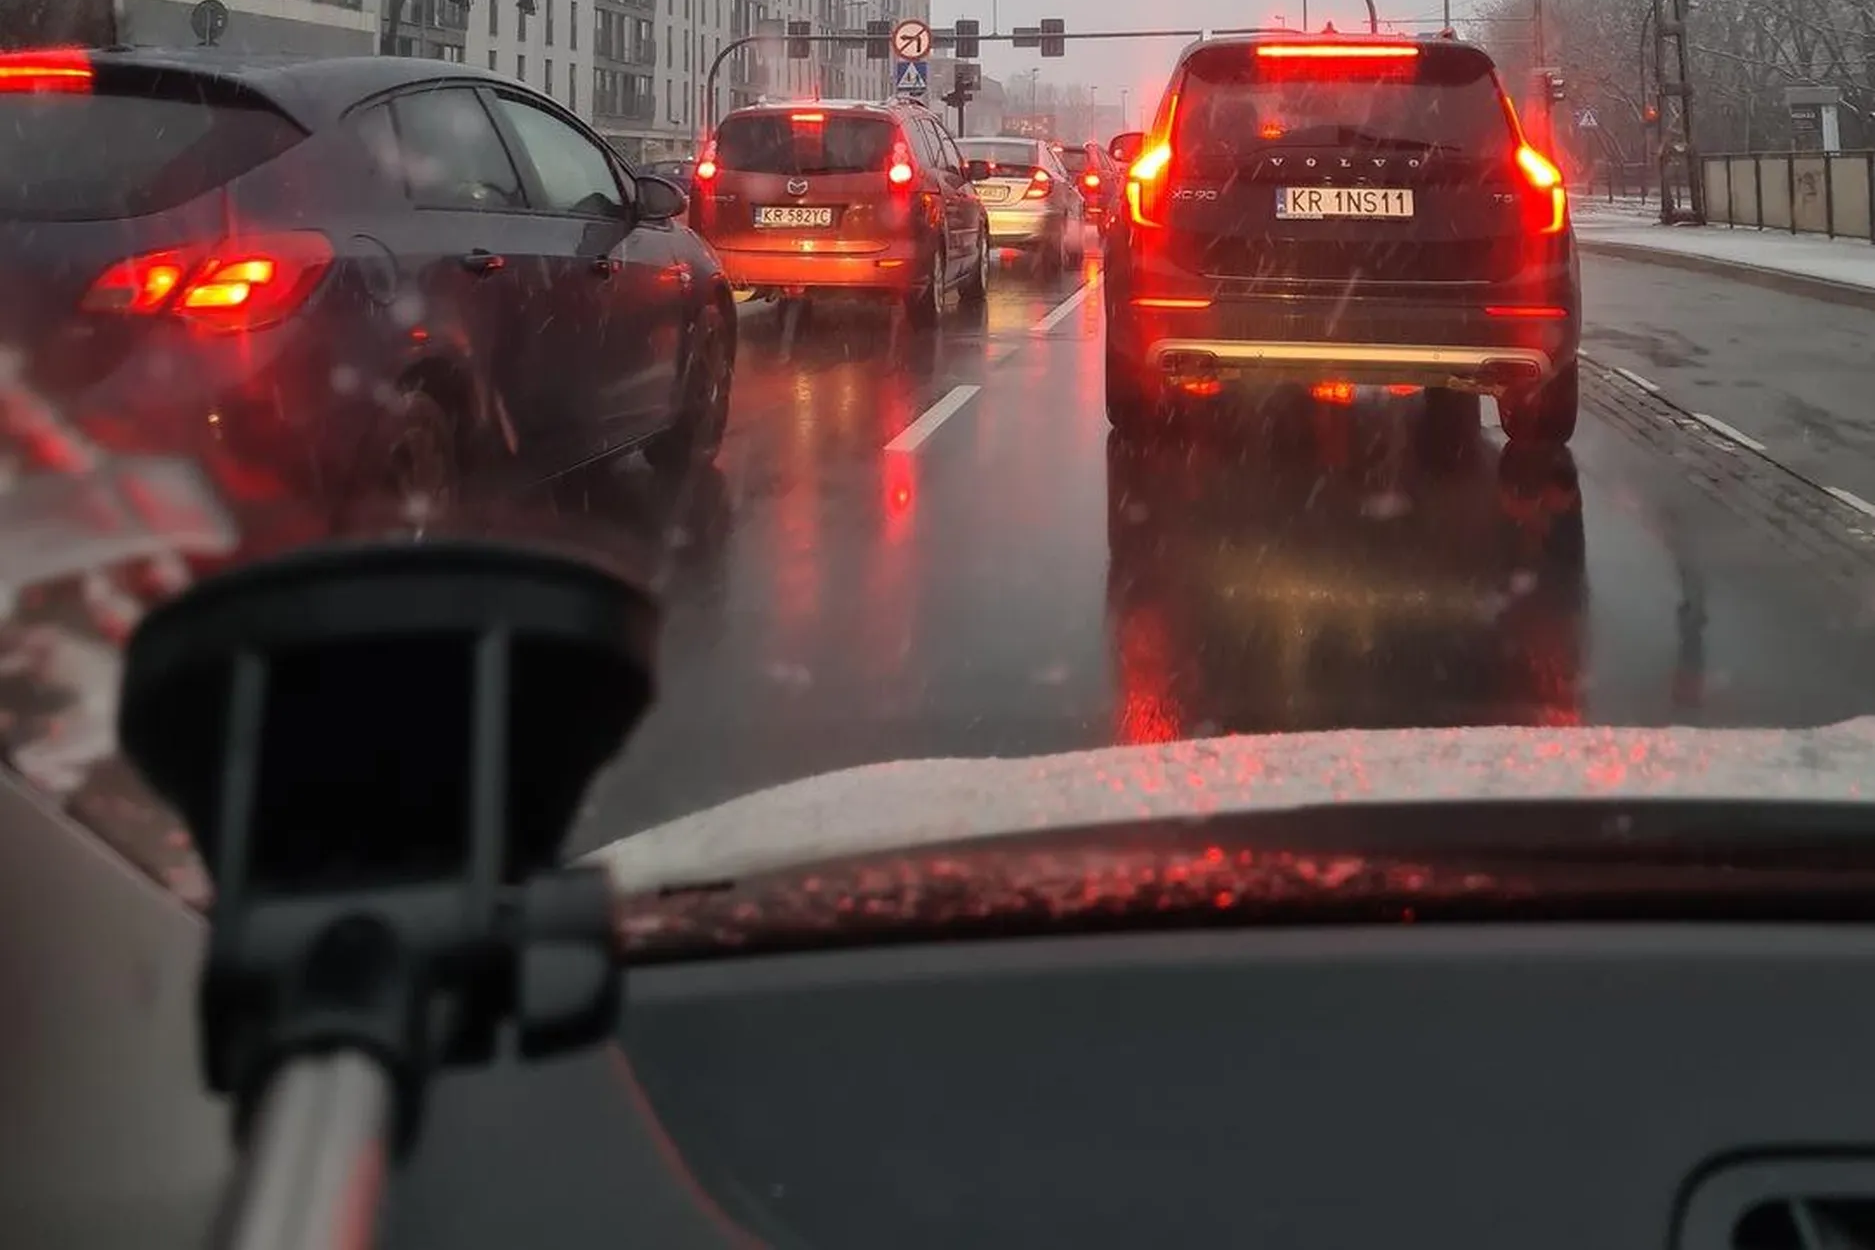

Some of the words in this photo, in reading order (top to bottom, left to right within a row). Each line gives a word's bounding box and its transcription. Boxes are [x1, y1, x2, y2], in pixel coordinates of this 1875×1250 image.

[1271, 157, 1420, 168] VOLVO
[1292, 190, 1323, 212] KR
[1334, 190, 1405, 214] 1NS11
[764, 209, 784, 223] KR
